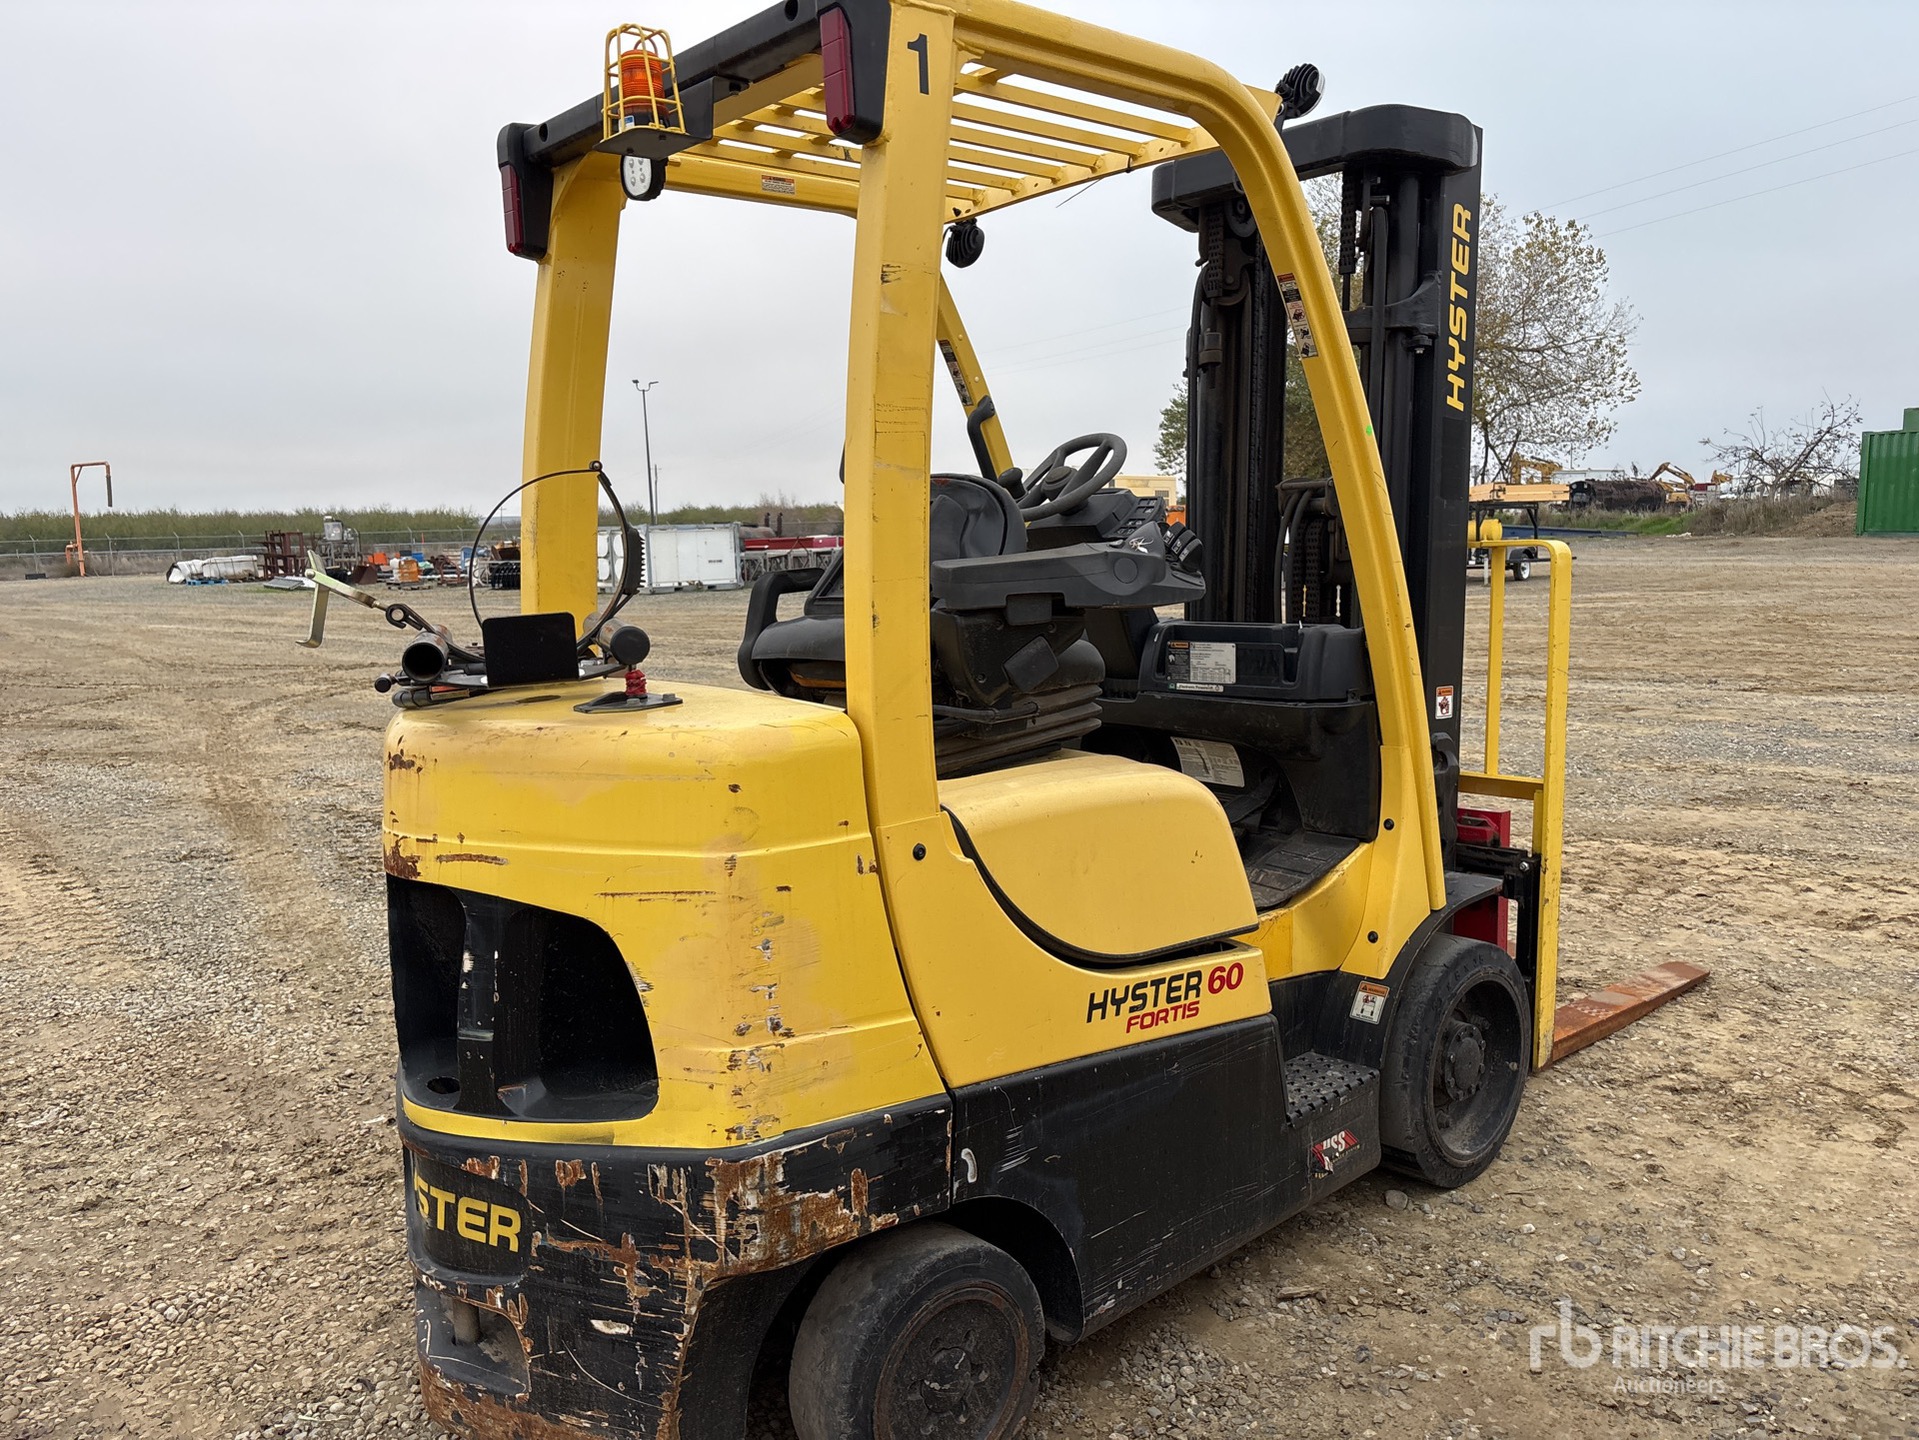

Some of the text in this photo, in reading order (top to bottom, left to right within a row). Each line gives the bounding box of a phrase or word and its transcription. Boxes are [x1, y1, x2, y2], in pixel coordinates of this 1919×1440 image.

[907, 32, 930, 96] 1
[1446, 202, 1472, 412] HYSTER
[1086, 961, 1244, 1024] HYSTER 60
[1125, 1000, 1201, 1034] FORTIS
